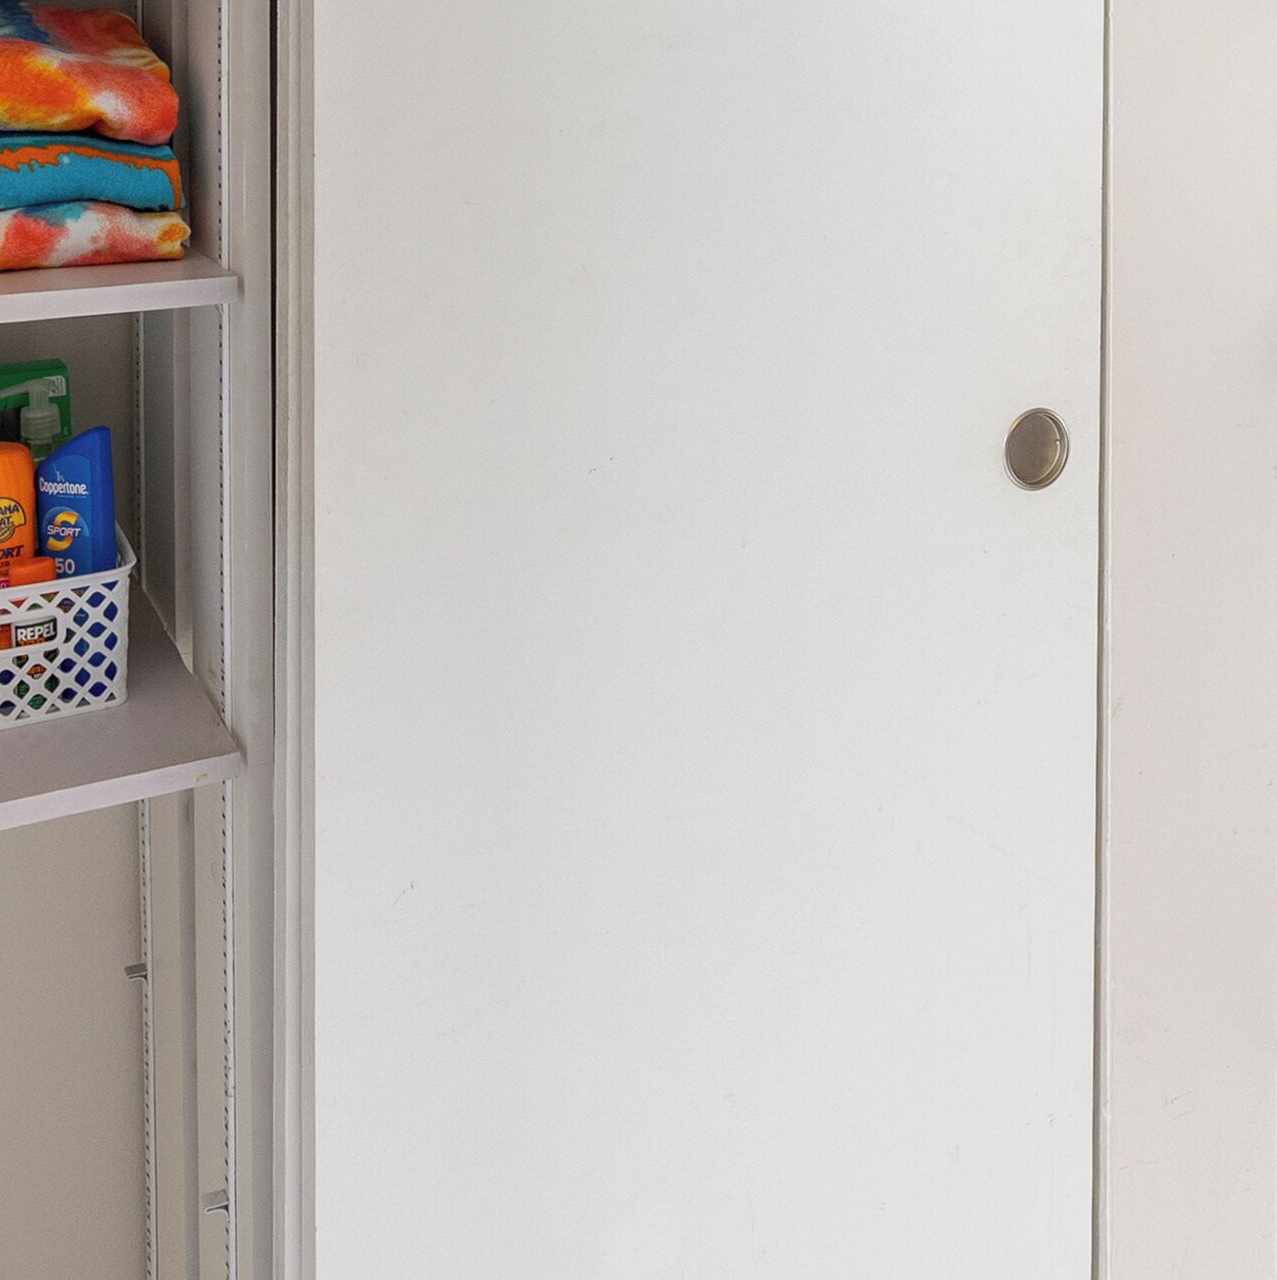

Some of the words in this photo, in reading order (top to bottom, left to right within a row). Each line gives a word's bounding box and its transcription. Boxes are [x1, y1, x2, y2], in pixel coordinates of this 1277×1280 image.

[39, 477, 87, 495] Coppertone
[47, 524, 82, 537] SPORT
[54, 558, 76, 575] 50
[17, 622, 56, 641] REPEL
